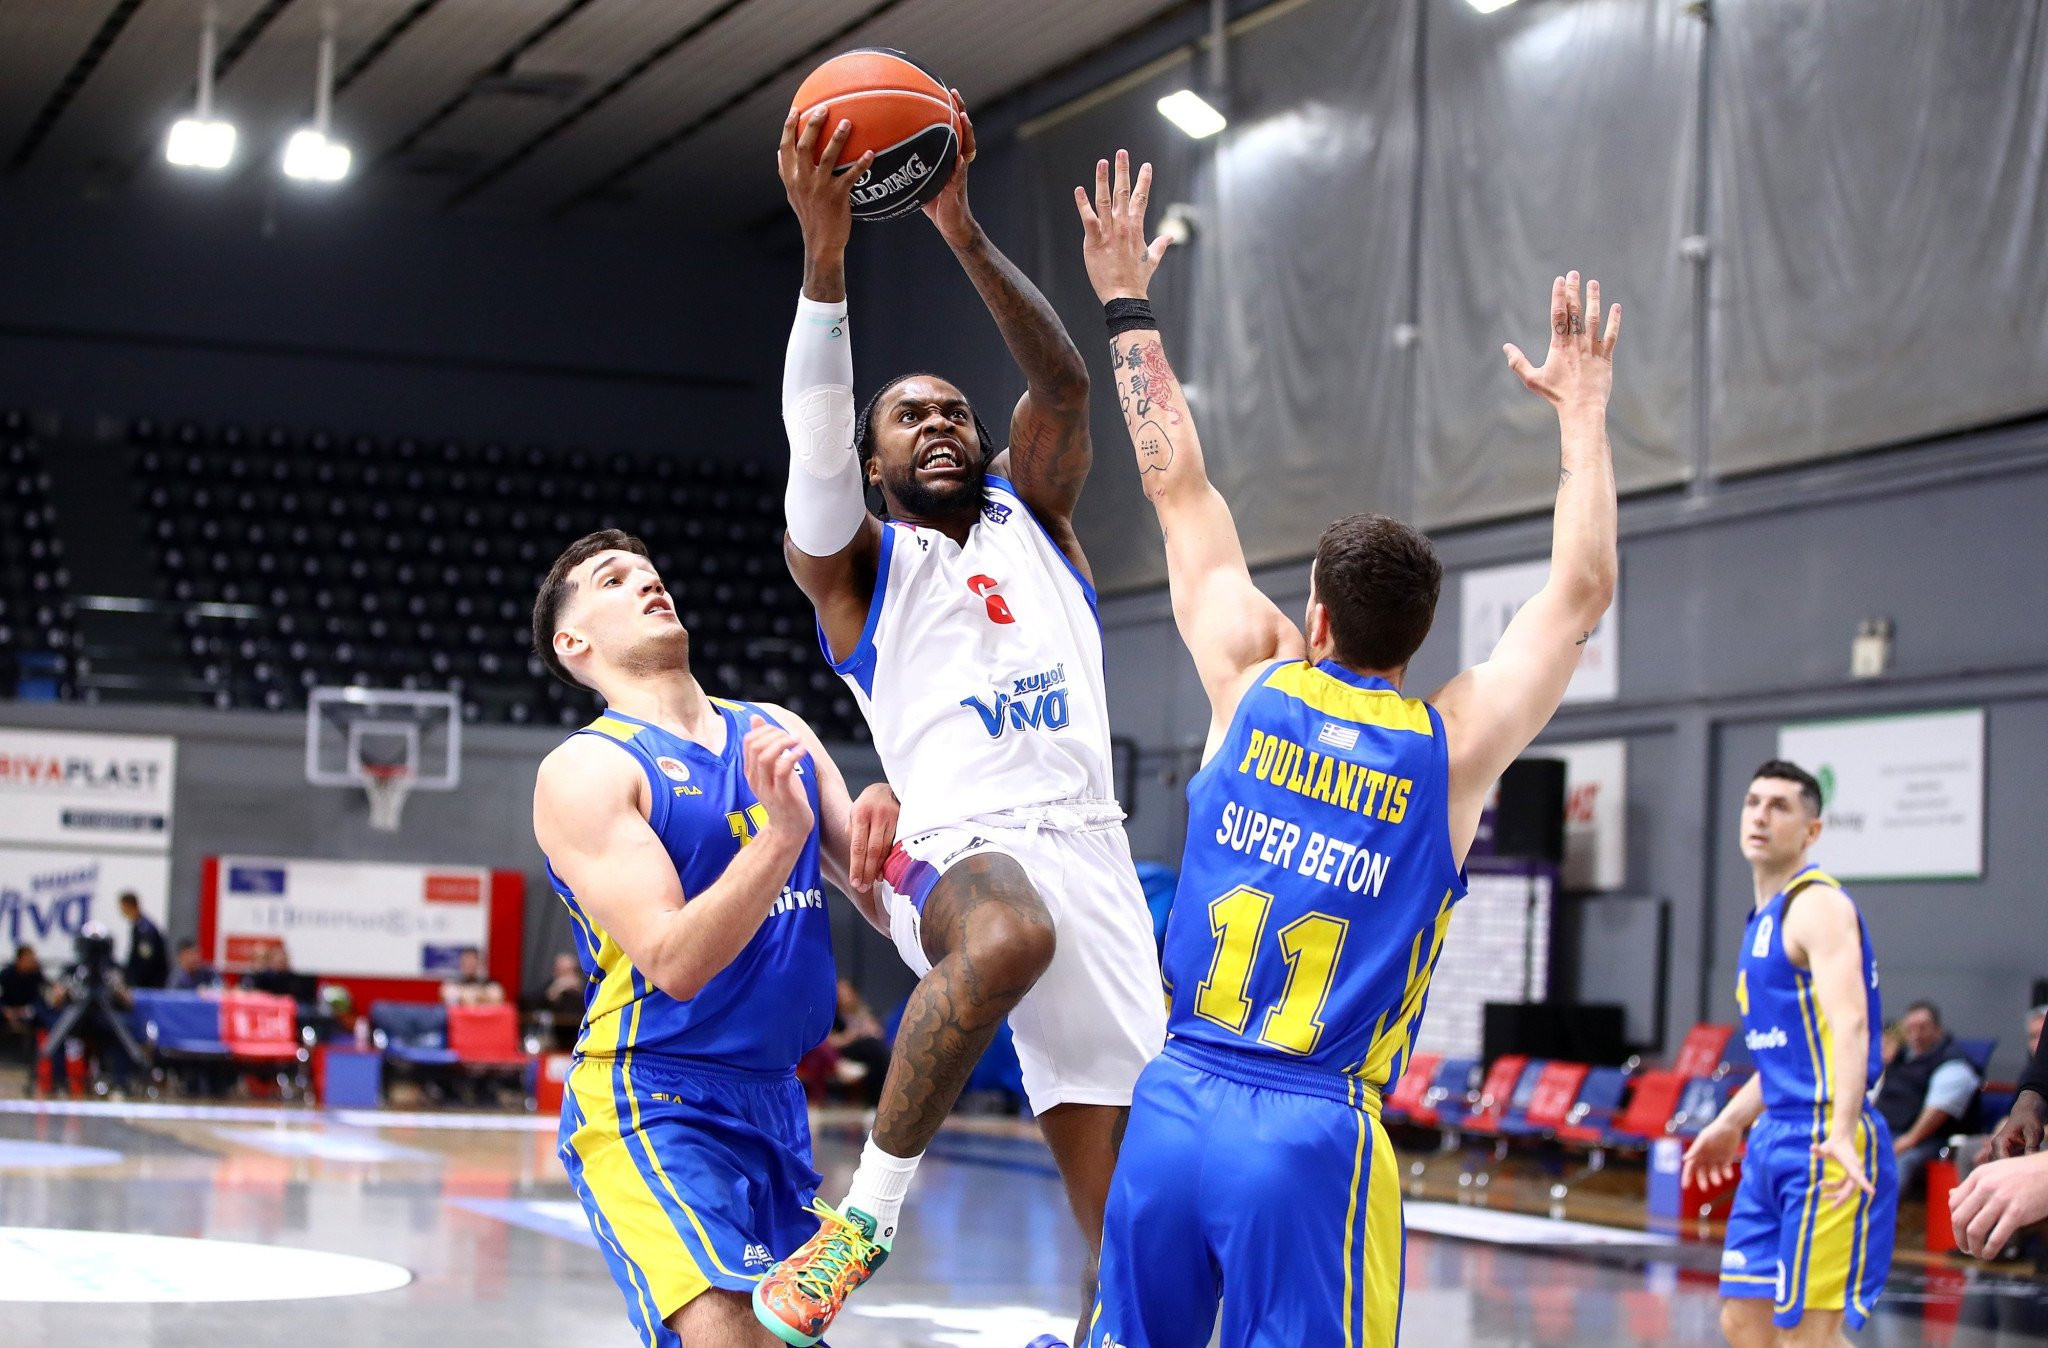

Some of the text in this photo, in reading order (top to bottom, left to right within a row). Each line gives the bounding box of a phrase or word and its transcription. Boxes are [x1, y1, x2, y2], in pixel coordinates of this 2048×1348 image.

[850, 152, 930, 207] ALDING
[966, 573, 1016, 625] 6
[673, 785, 703, 798] FILA
[1237, 728, 1413, 825] POULIANITIS
[1215, 801, 1391, 898] SUPER BETON
[1194, 884, 1350, 1056] 11
